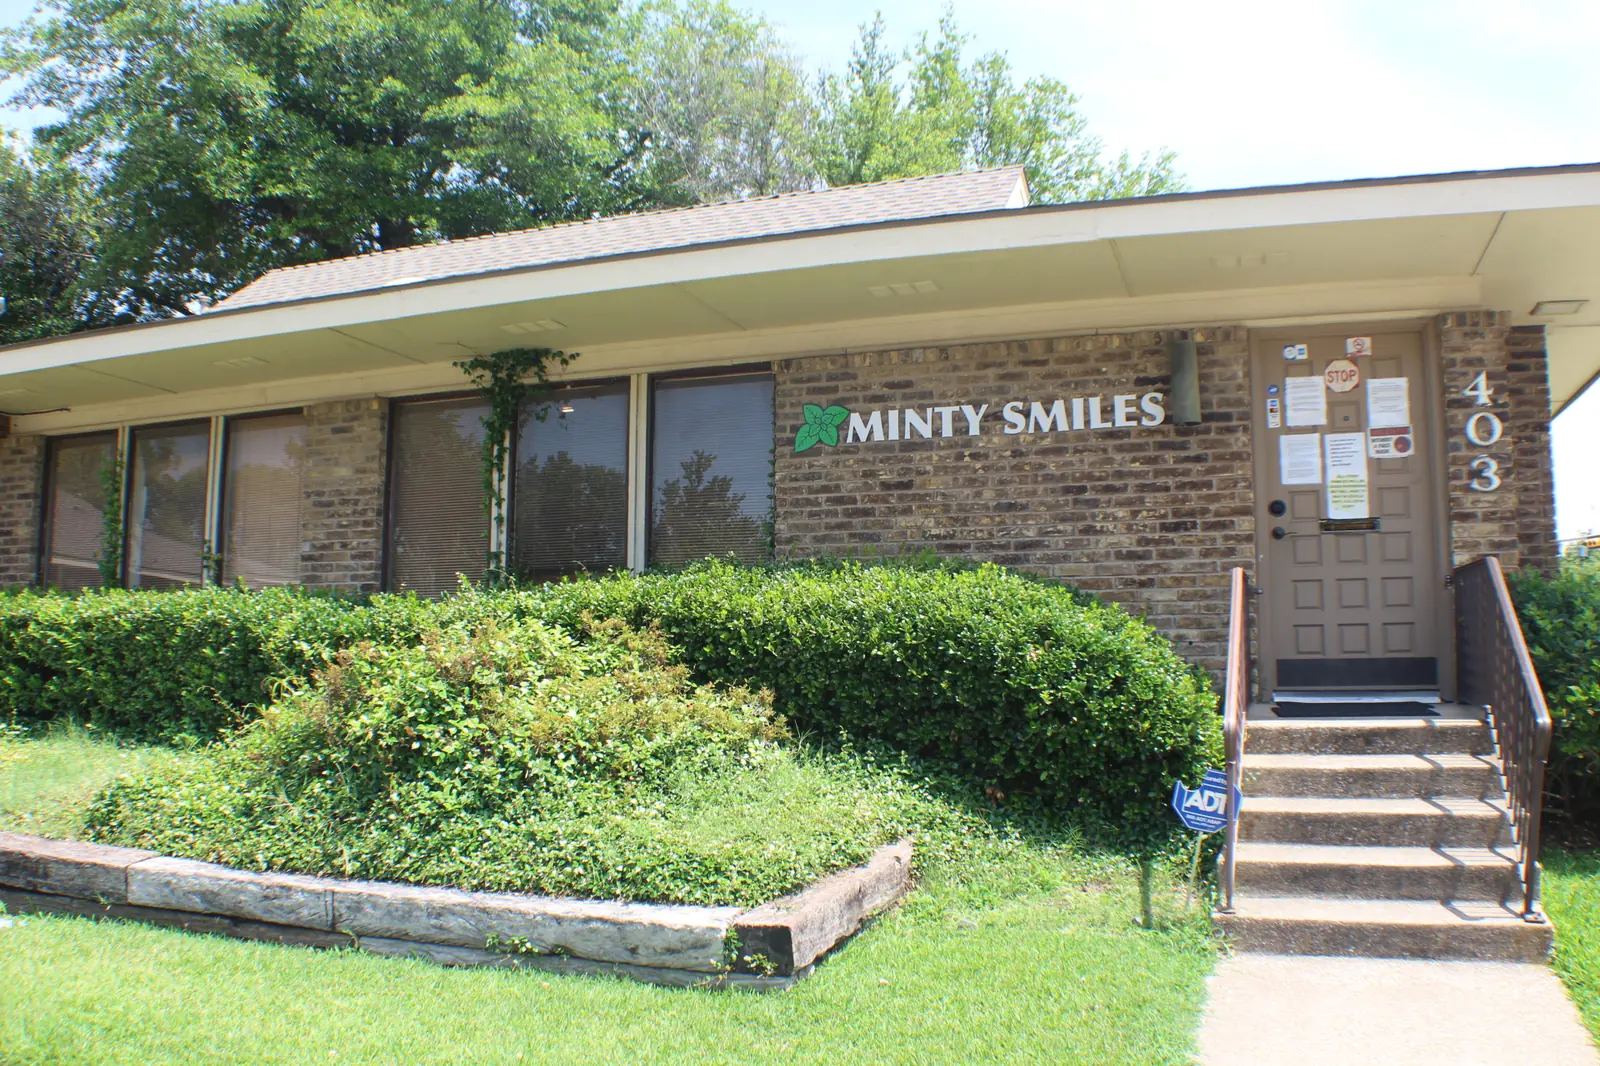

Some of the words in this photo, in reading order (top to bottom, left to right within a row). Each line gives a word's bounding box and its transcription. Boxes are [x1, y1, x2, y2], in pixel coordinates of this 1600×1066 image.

[1327, 369, 1357, 383] STOP
[845, 403, 989, 444] MINTY
[1003, 392, 1166, 435] SMILES
[1462, 370, 1504, 492] 403
[1184, 789, 1227, 814] ADT
